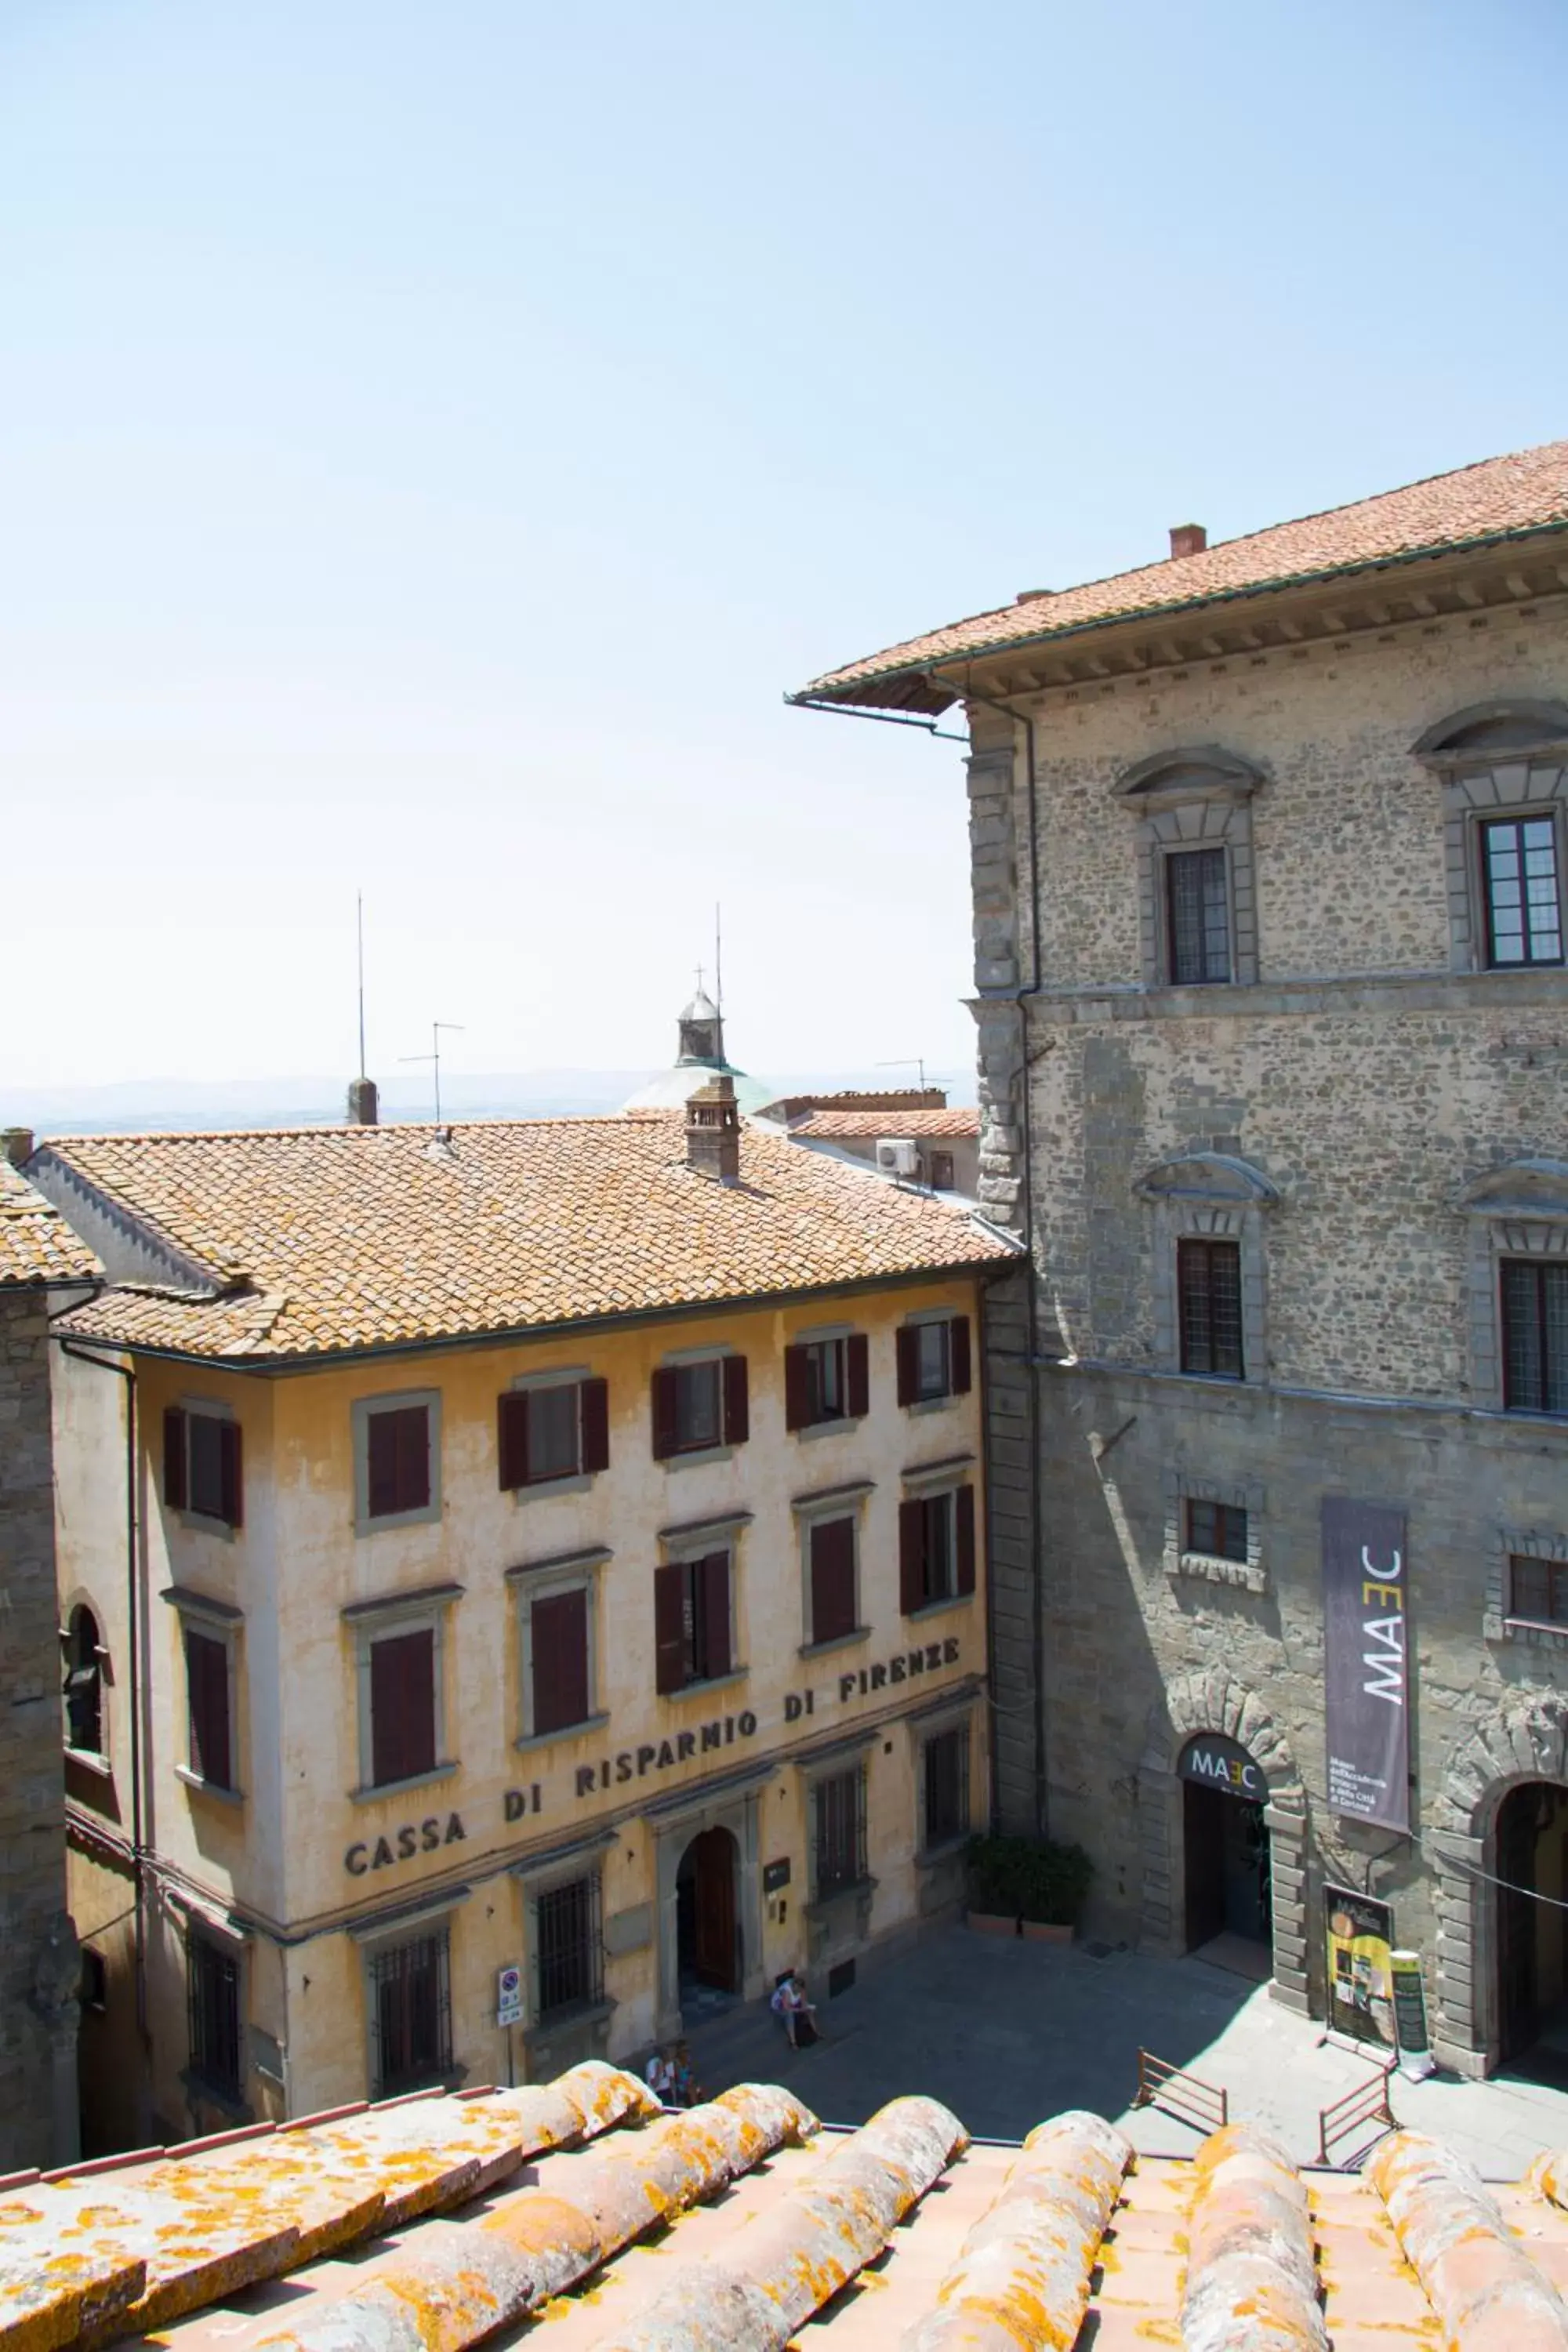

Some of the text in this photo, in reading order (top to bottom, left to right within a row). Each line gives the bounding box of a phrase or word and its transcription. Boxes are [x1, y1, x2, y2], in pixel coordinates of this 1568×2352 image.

[344, 1636, 960, 1877] CASSA DI RISPARMIO DI FIRENZE
